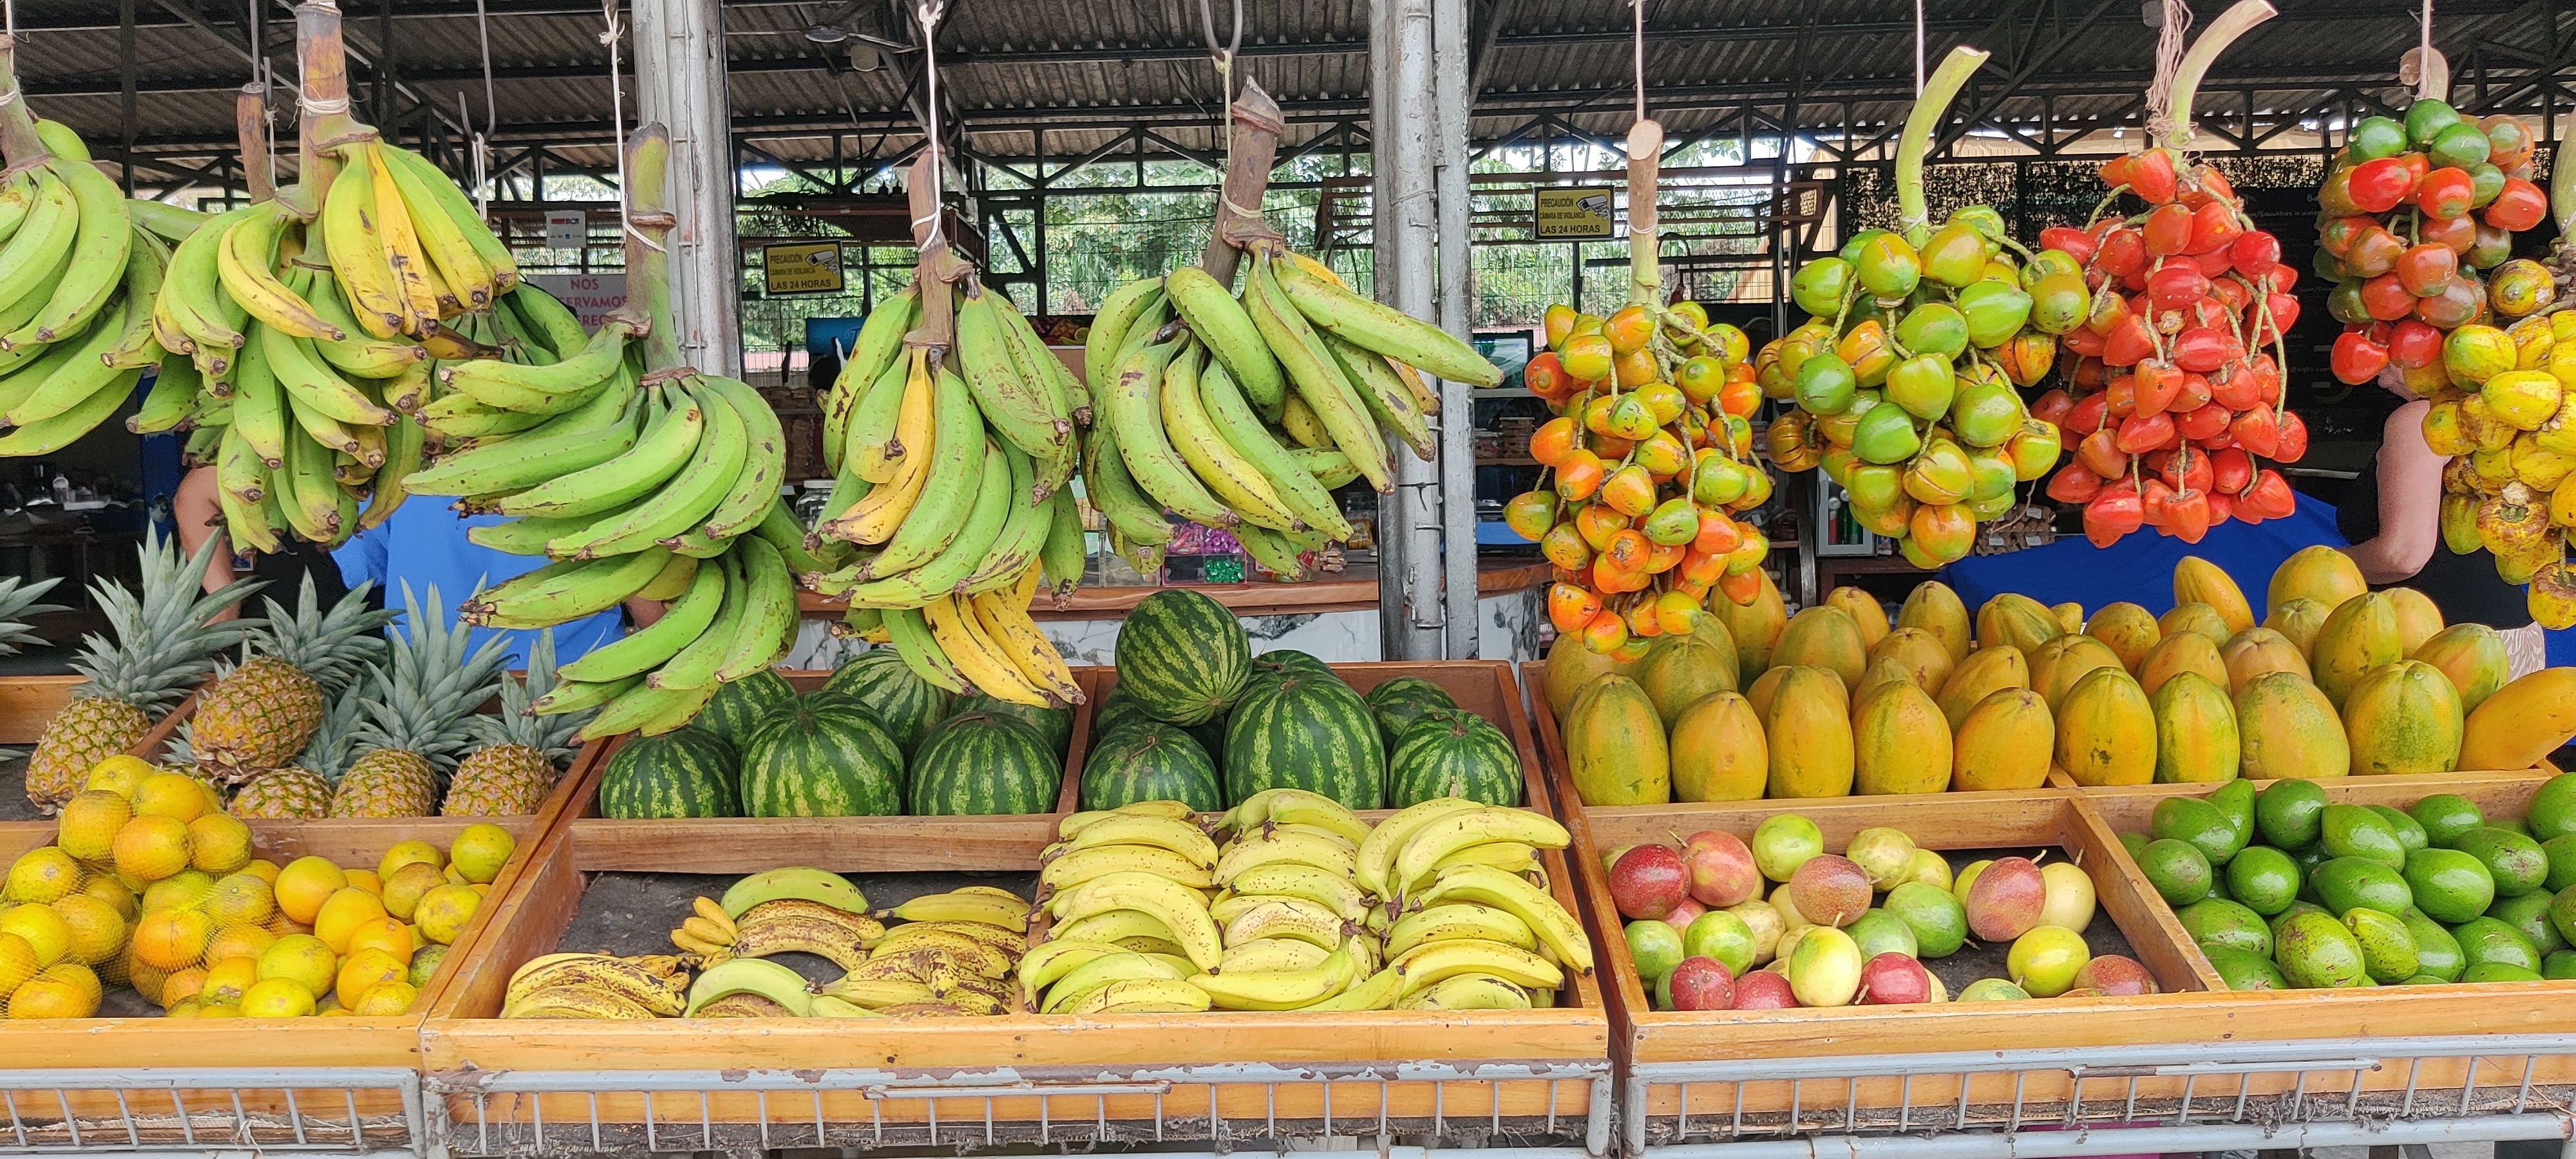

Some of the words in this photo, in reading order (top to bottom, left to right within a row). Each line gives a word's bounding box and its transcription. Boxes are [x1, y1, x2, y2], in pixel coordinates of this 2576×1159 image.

[1540, 196, 1574, 207] PRECAUCIÓN
[1540, 225, 1557, 234] LAS
[1558, 225, 1567, 234] 24
[1570, 225, 1600, 233] HORAS
[770, 252, 803, 265] PRECAUCIÓN
[571, 278, 599, 290] NOS
[772, 281, 788, 290] LAS
[790, 281, 799, 289] 24
[801, 279, 831, 288] HORAS
